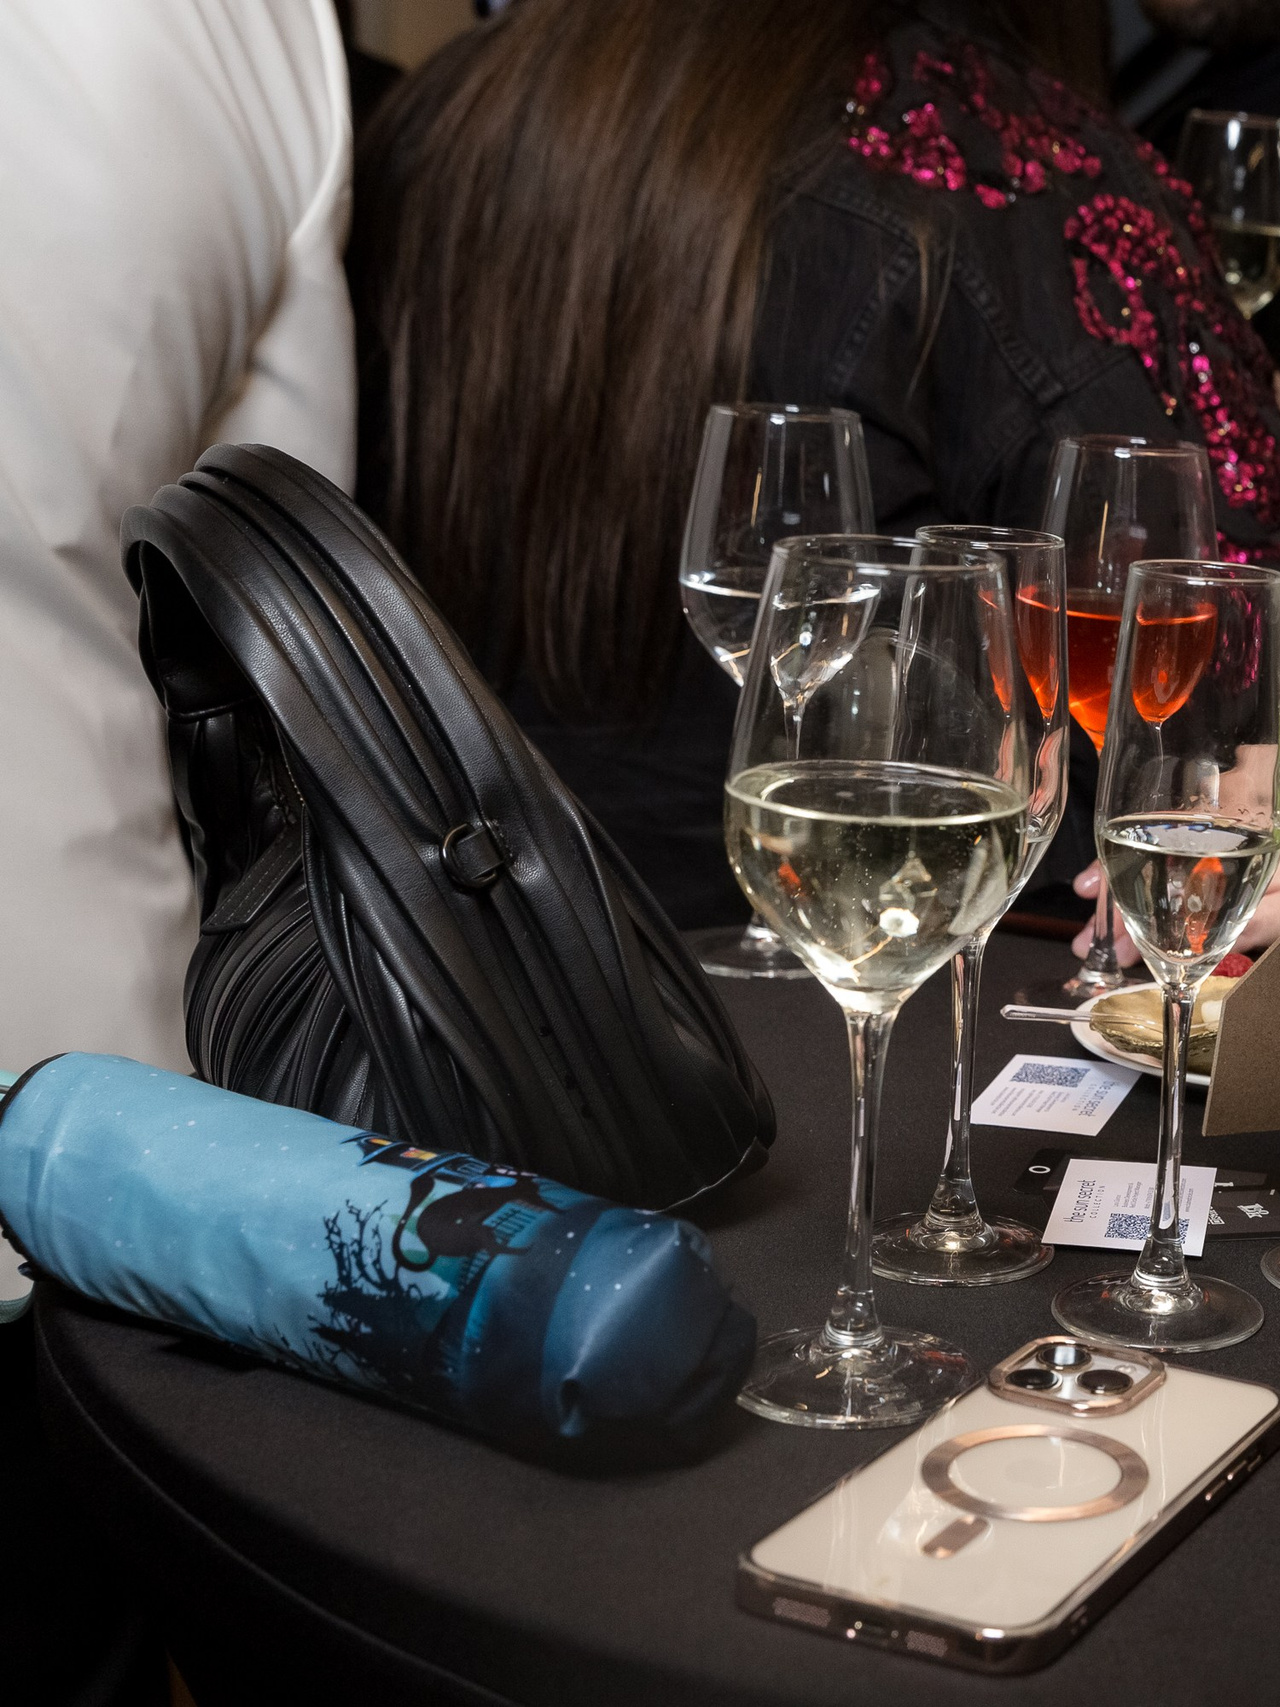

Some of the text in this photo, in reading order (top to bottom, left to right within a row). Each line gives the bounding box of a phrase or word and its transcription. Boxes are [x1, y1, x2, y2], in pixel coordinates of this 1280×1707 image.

[1063, 1179, 1097, 1223] the sun secret
[1089, 1185, 1106, 1219] COLLECTION
